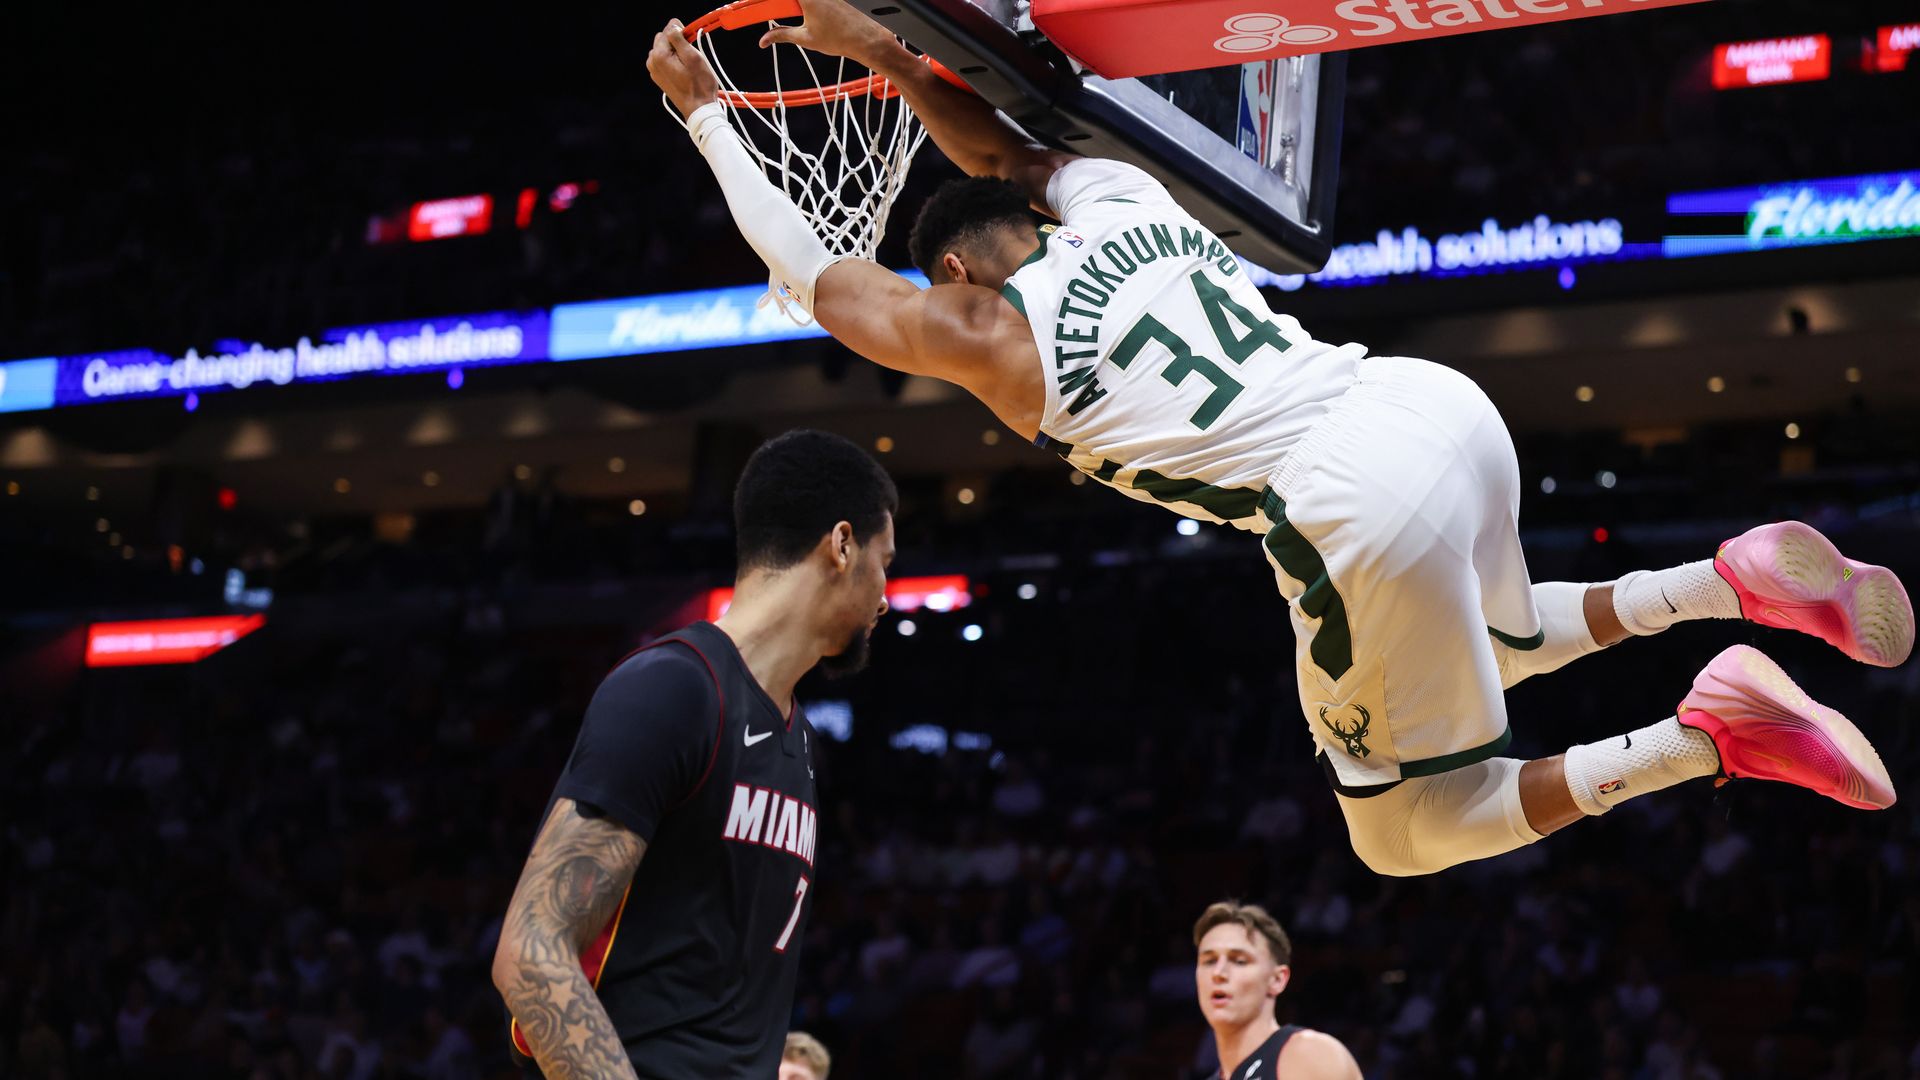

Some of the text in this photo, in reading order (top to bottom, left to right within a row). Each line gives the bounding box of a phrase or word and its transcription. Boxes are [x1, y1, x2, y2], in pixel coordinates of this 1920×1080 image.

[1435, 214, 1623, 269] solutions
[296, 328, 387, 377] health
[387, 321, 523, 368] solutions
[1055, 223, 1239, 416] ANTETOKOUNMPO
[1108, 268, 1293, 432] 34
[774, 874, 810, 951] 7
